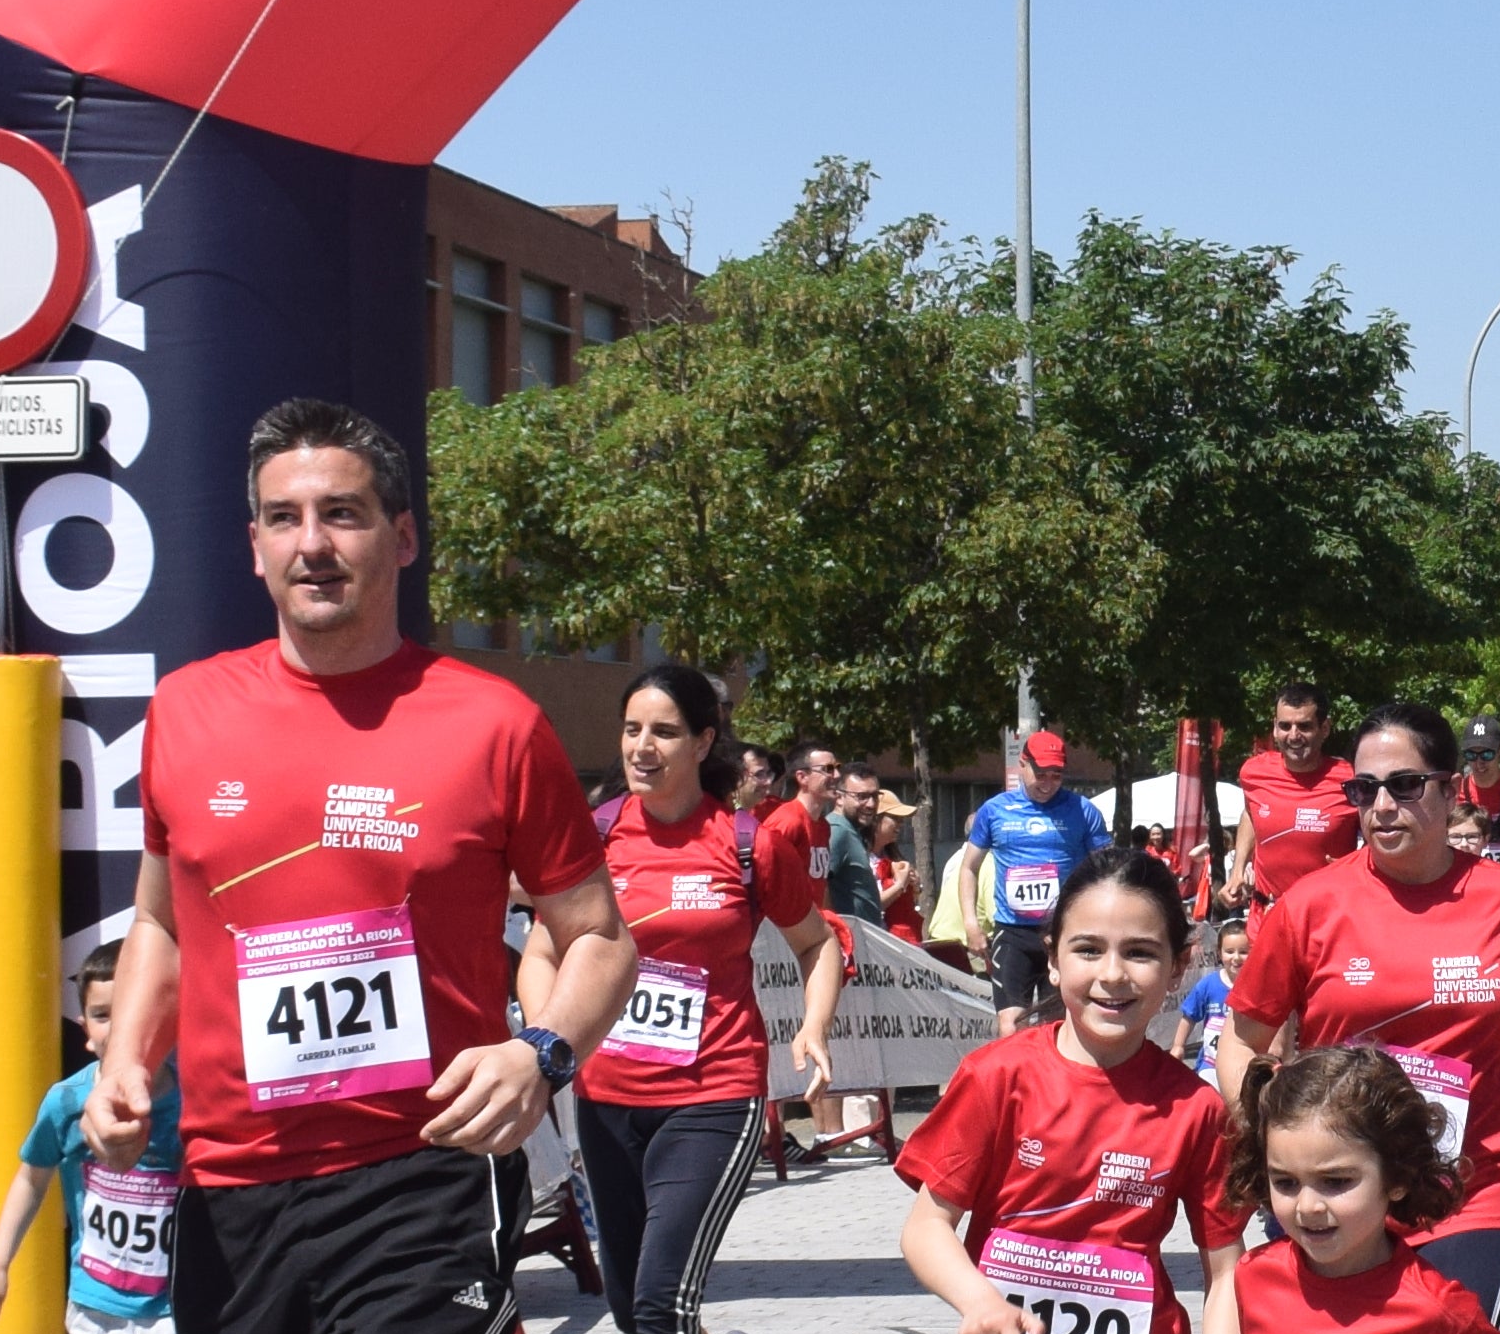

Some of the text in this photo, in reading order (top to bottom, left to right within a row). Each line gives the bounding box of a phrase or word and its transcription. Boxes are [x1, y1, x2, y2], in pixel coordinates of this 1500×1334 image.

[327, 784, 395, 803] CARRERA
[325, 800, 387, 817] CAMPUS
[323, 816, 419, 838] UNIVERSIDAD
[322, 832, 403, 853] DE LA RIOJA
[1014, 883, 1051, 901] 4117
[245, 922, 354, 947] CARRERA CAMPUS
[246, 926, 403, 960] UNIVERSIDAD DE LA RIOJA
[247, 962, 289, 977] DOMINGO
[339, 953, 352, 964] DE
[353, 950, 376, 962] 2022
[1432, 956, 1481, 968] CARRERA
[1433, 967, 1478, 980] CAMPUS
[266, 970, 399, 1045] 4121
[1433, 991, 1496, 1005] DE LA RIOJA
[620, 989, 693, 1030] 051
[871, 1015, 905, 1039] RIOJA
[297, 1042, 377, 1063] CARRERA FAMILIAR
[1413, 1067, 1464, 1086] DE LA RIOJA
[1102, 1151, 1150, 1169] CARRERA
[1100, 1164, 1145, 1182] CAMPUS
[1098, 1178, 1165, 1197] UNIVERSIDAD
[1095, 1190, 1153, 1208] DE LA RIOJA
[993, 1237, 1102, 1266] CARRERA CAMPUS
[990, 1249, 1145, 1284] UNIVERSIDAD DE LA RIOJA
[986, 1267, 1116, 1296] DOMINGO 15 DE MAYO DE 2022
